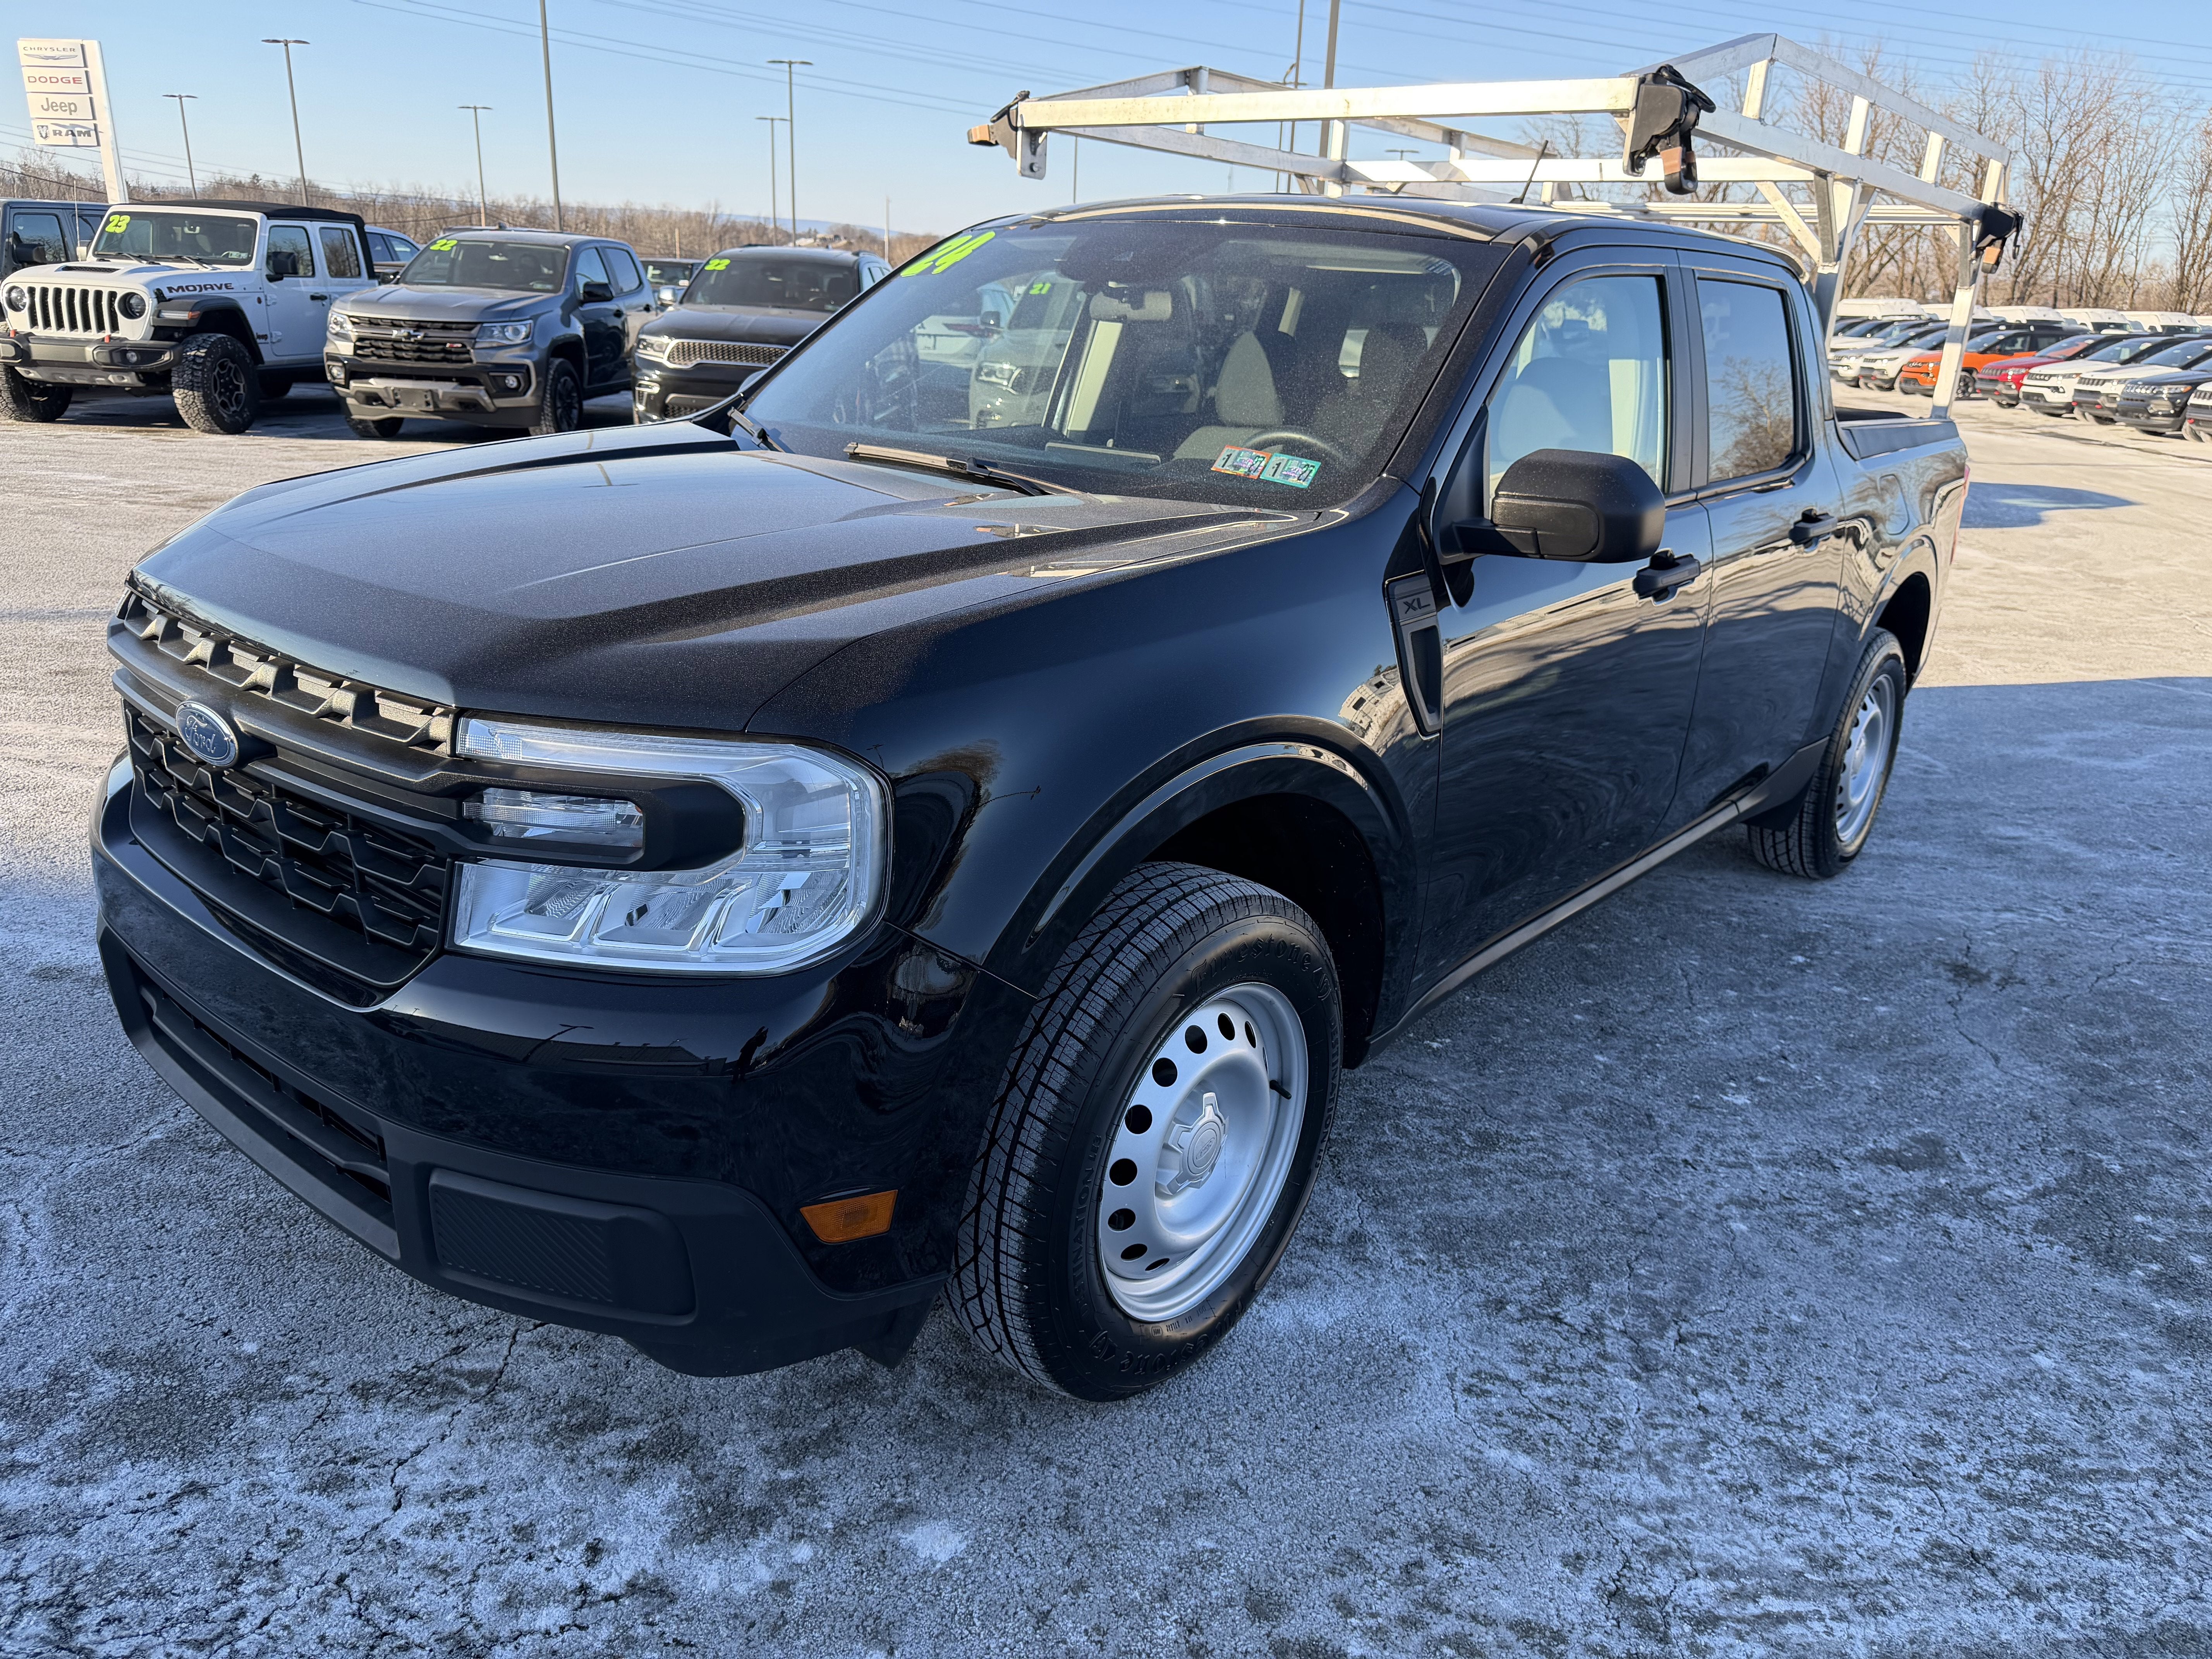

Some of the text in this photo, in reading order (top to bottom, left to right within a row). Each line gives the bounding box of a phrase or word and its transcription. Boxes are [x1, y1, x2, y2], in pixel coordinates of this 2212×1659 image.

[28, 76, 82, 84] DODGE
[41, 98, 77, 115] Jeep
[105, 215, 131, 234] 23
[429, 239, 458, 251] 22
[704, 259, 731, 271] 22
[167, 283, 234, 294] MOJAVE
[1029, 282, 1052, 295] 21
[1403, 598, 1431, 614] XL
[185, 714, 216, 754] Ford
[1190, 933, 1312, 994] Firestone
[1321, 1015, 1341, 1145] DESTINATION
[1072, 1166, 1095, 1317] DESTINATION
